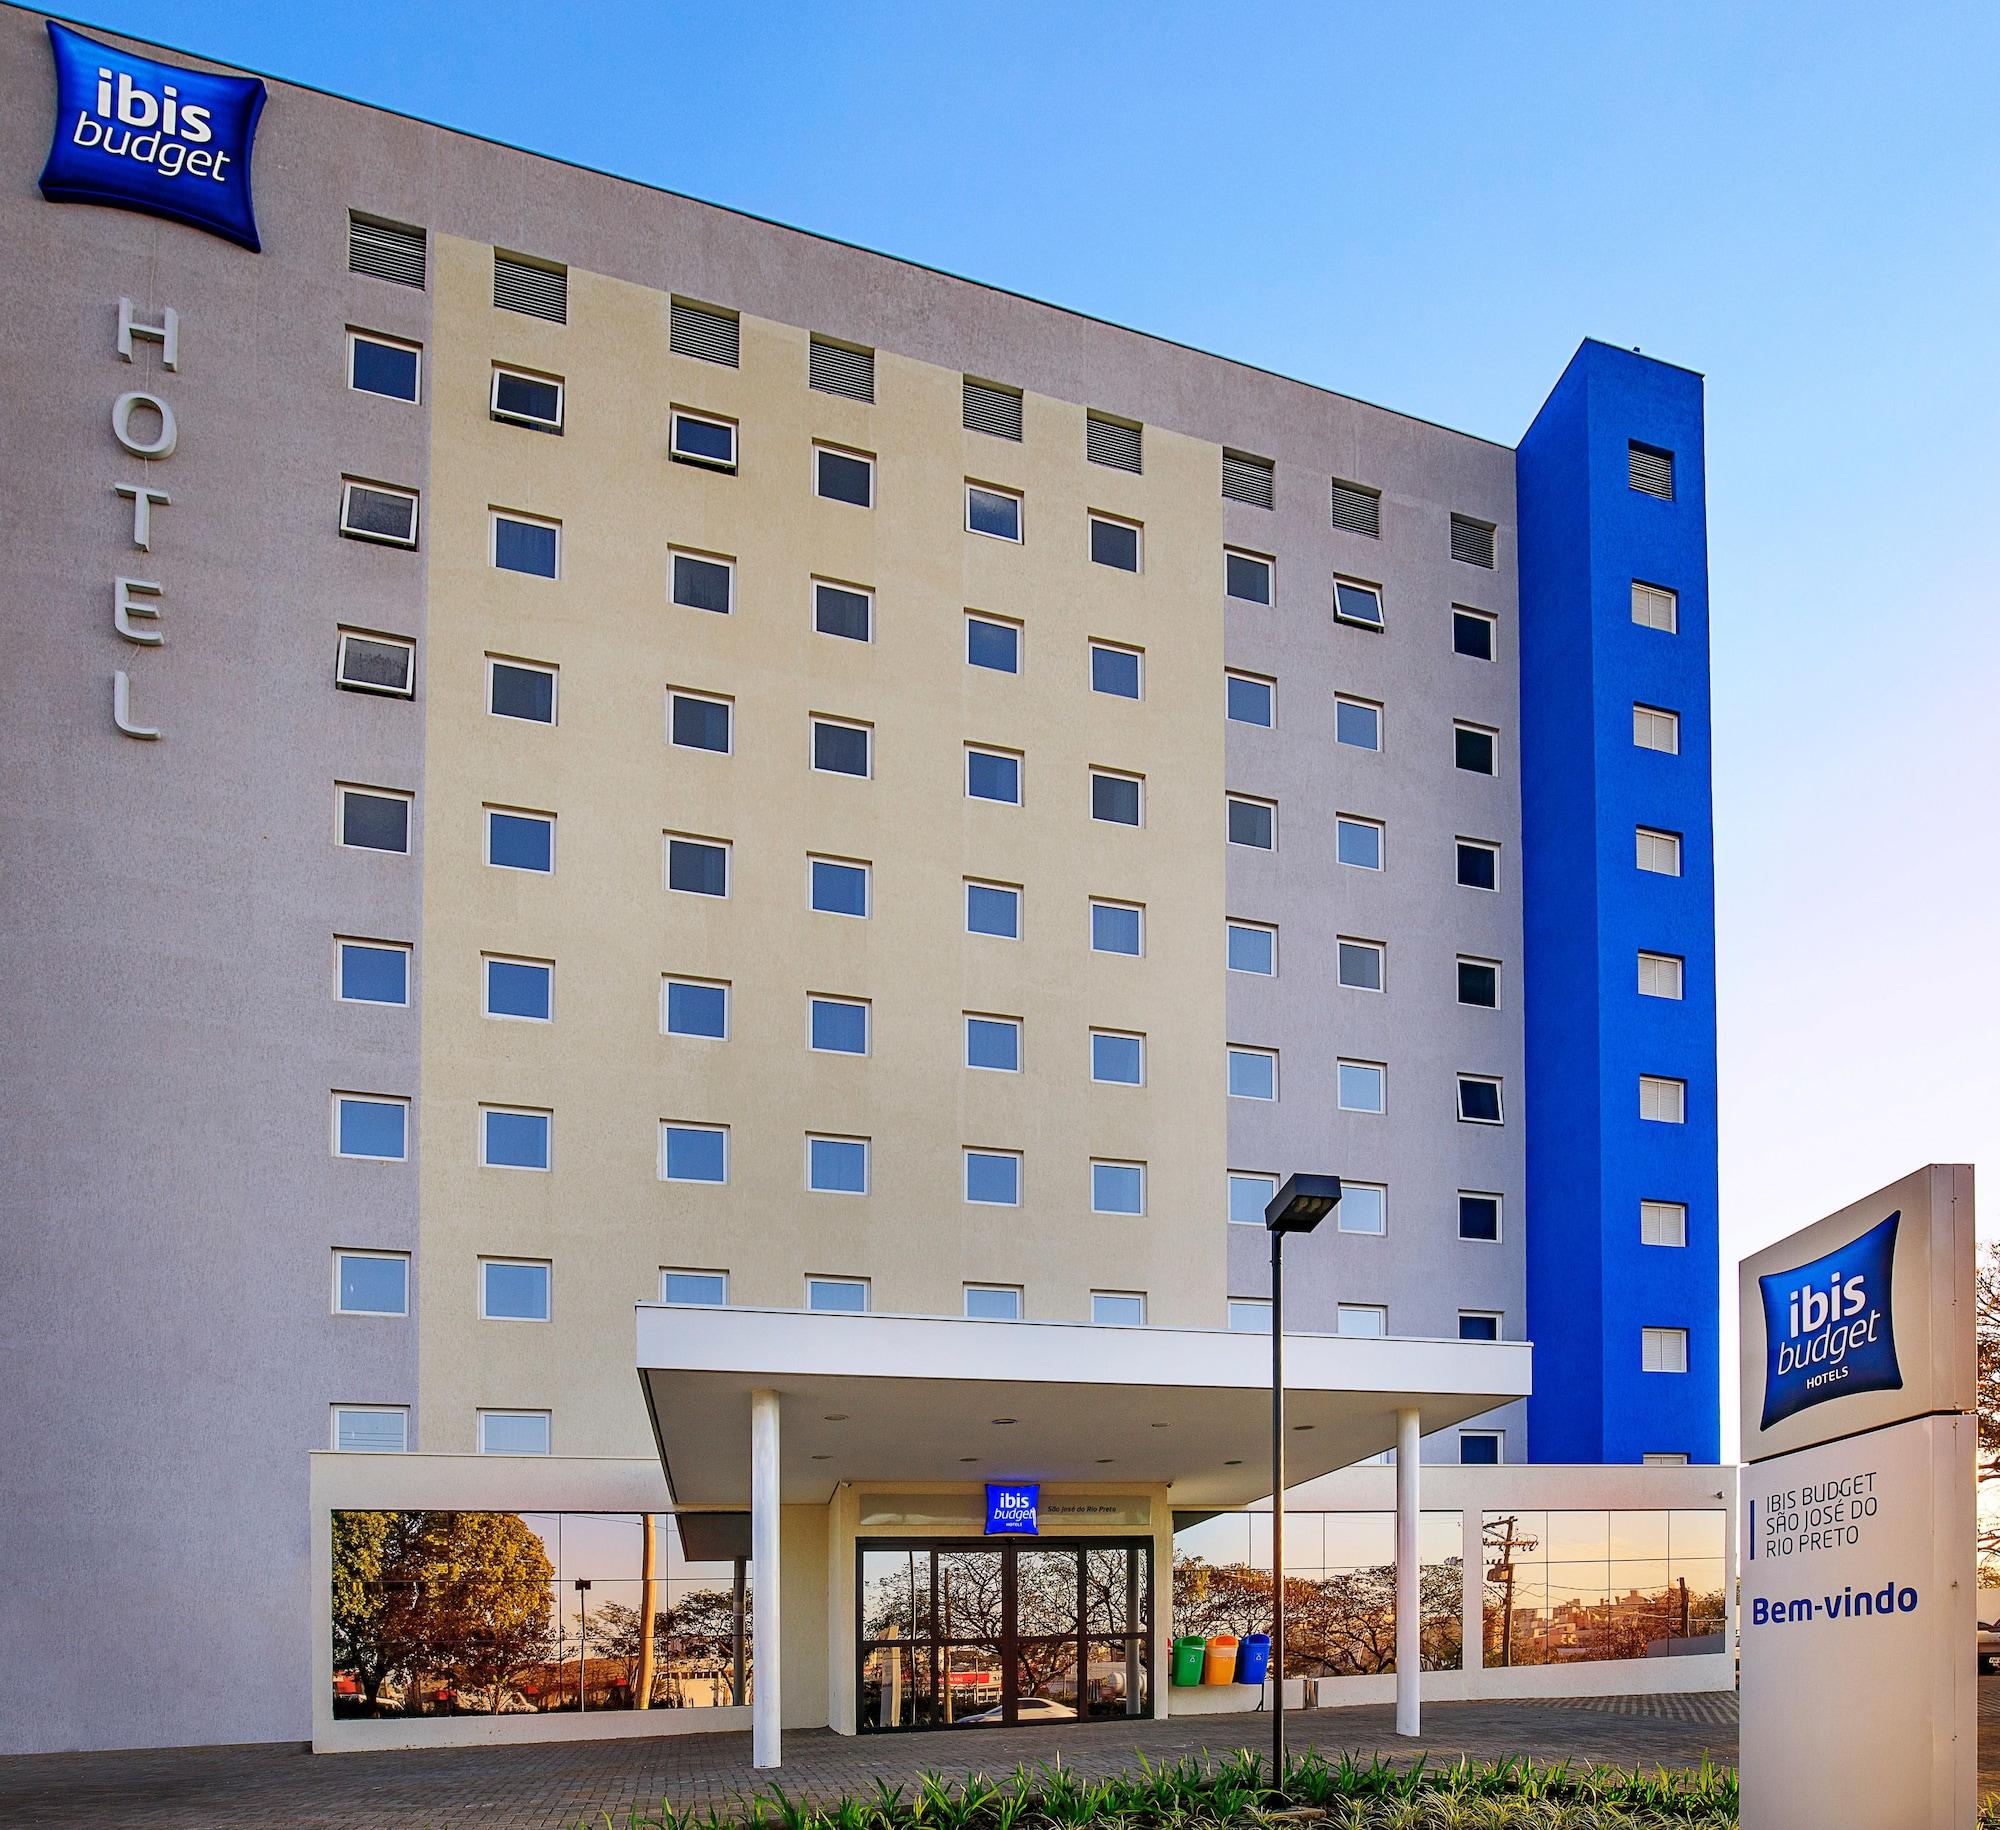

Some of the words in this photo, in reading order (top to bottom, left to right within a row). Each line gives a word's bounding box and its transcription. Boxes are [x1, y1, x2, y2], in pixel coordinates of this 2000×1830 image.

[97, 67, 212, 143] ibis
[73, 111, 231, 183] budget
[112, 296, 180, 741] HOTEL
[1789, 1271, 1867, 1338] ibis
[1777, 1308, 1881, 1377] budget
[1805, 1365, 1849, 1390] HOTELS
[1000, 1492, 1030, 1508] ibis
[1076, 1505, 1086, 1513] do
[1087, 1505, 1098, 1513] Rio
[1098, 1505, 1117, 1513] Preto
[1766, 1487, 1796, 1513] IBIS
[1801, 1471, 1878, 1504] BUDGET
[994, 1507, 1034, 1522] budget
[1766, 1510, 1800, 1536] SÃO
[1803, 1497, 1845, 1534] JOSÉ
[1850, 1495, 1879, 1520] DO
[1766, 1532, 1795, 1558] RIO
[1799, 1525, 1860, 1553] PRETO
[1752, 1581, 1919, 1626] Bem-vindo
